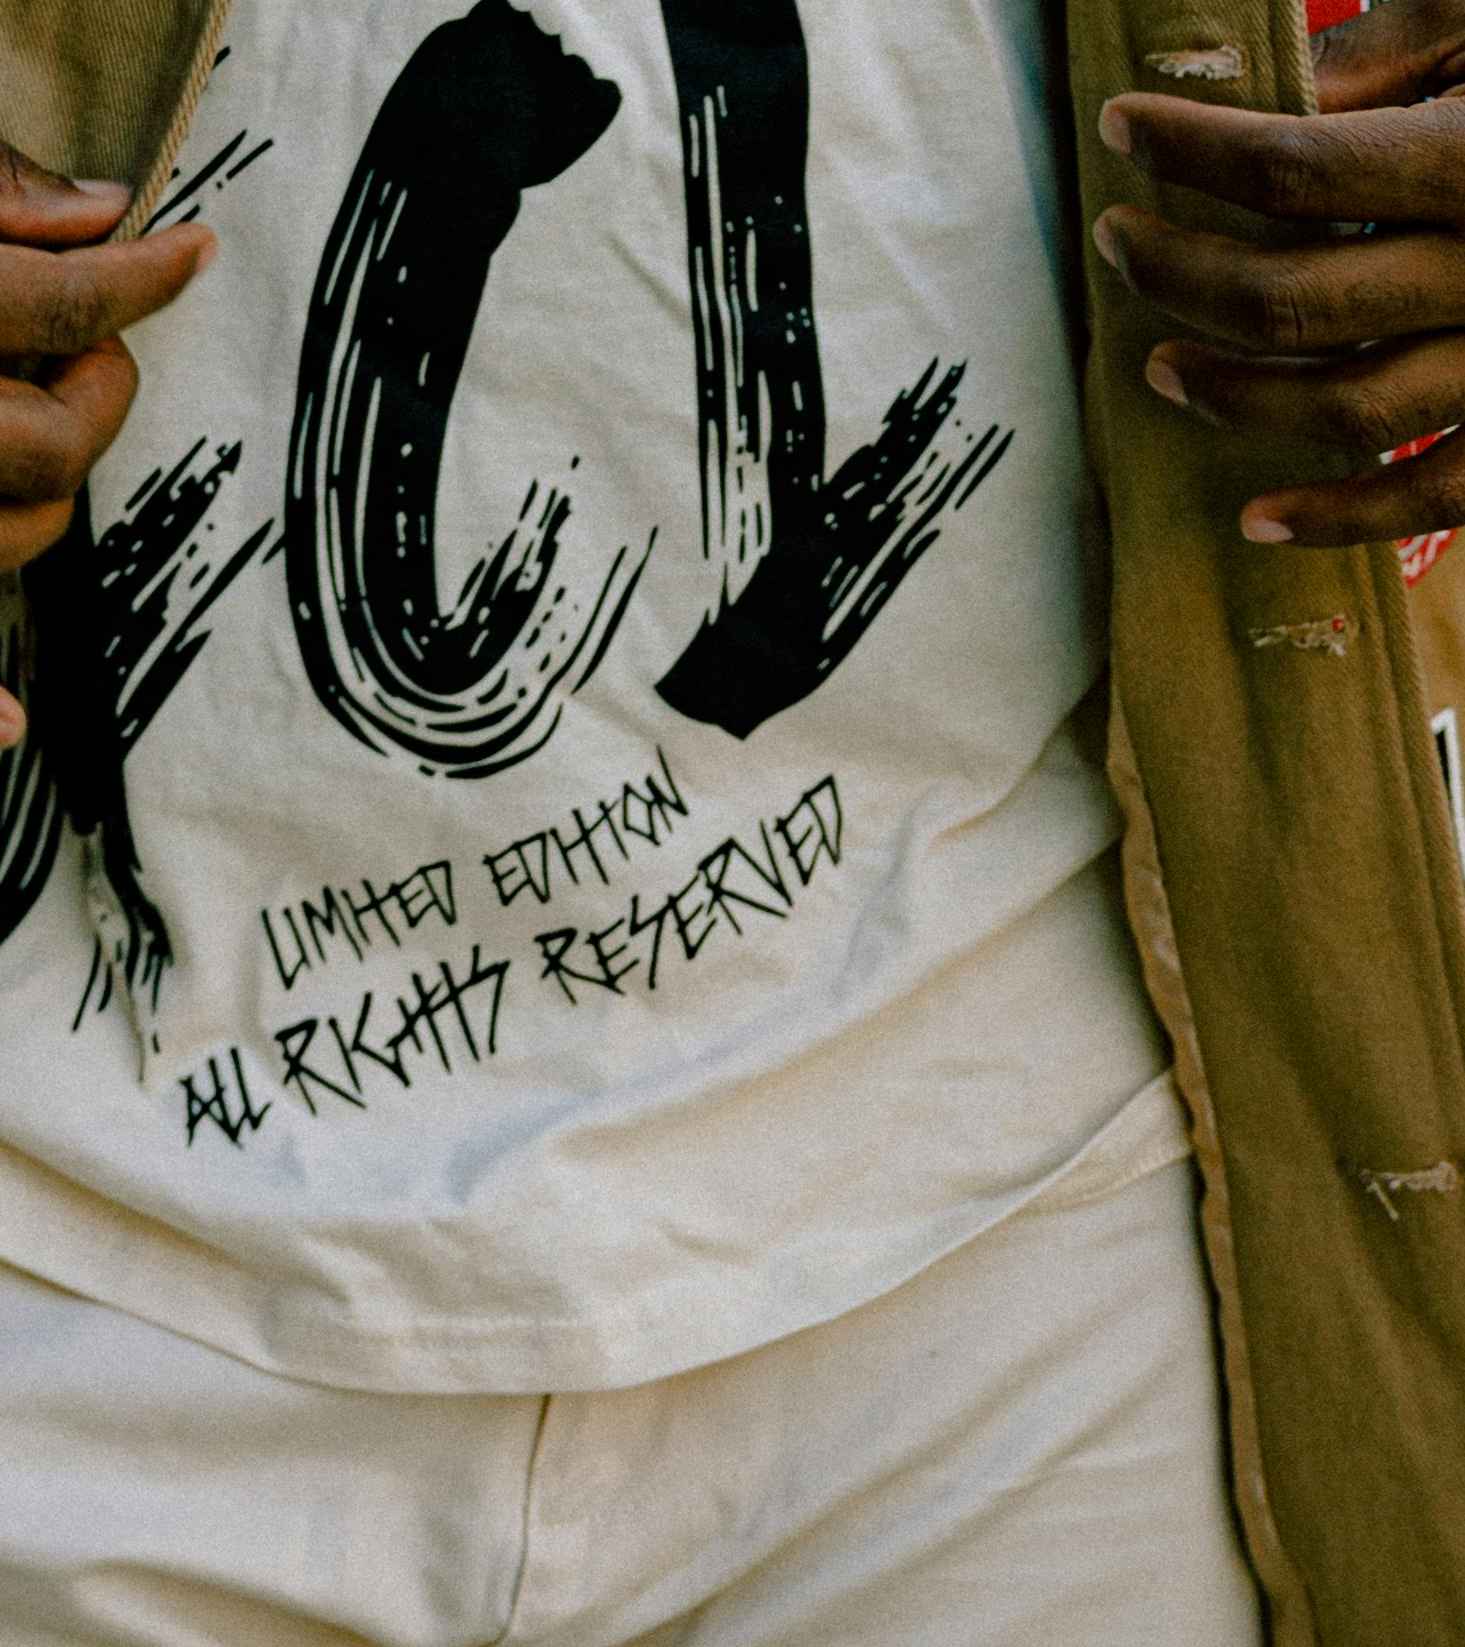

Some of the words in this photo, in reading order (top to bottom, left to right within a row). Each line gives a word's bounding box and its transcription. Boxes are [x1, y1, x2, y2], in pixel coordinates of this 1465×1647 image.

[176, 1046, 274, 1150] ALL
[273, 942, 513, 1117] RIGHTS
[533, 772, 844, 1006] RESERVED
[260, 857, 458, 990] LIMITED
[482, 743, 690, 906] EDITION
